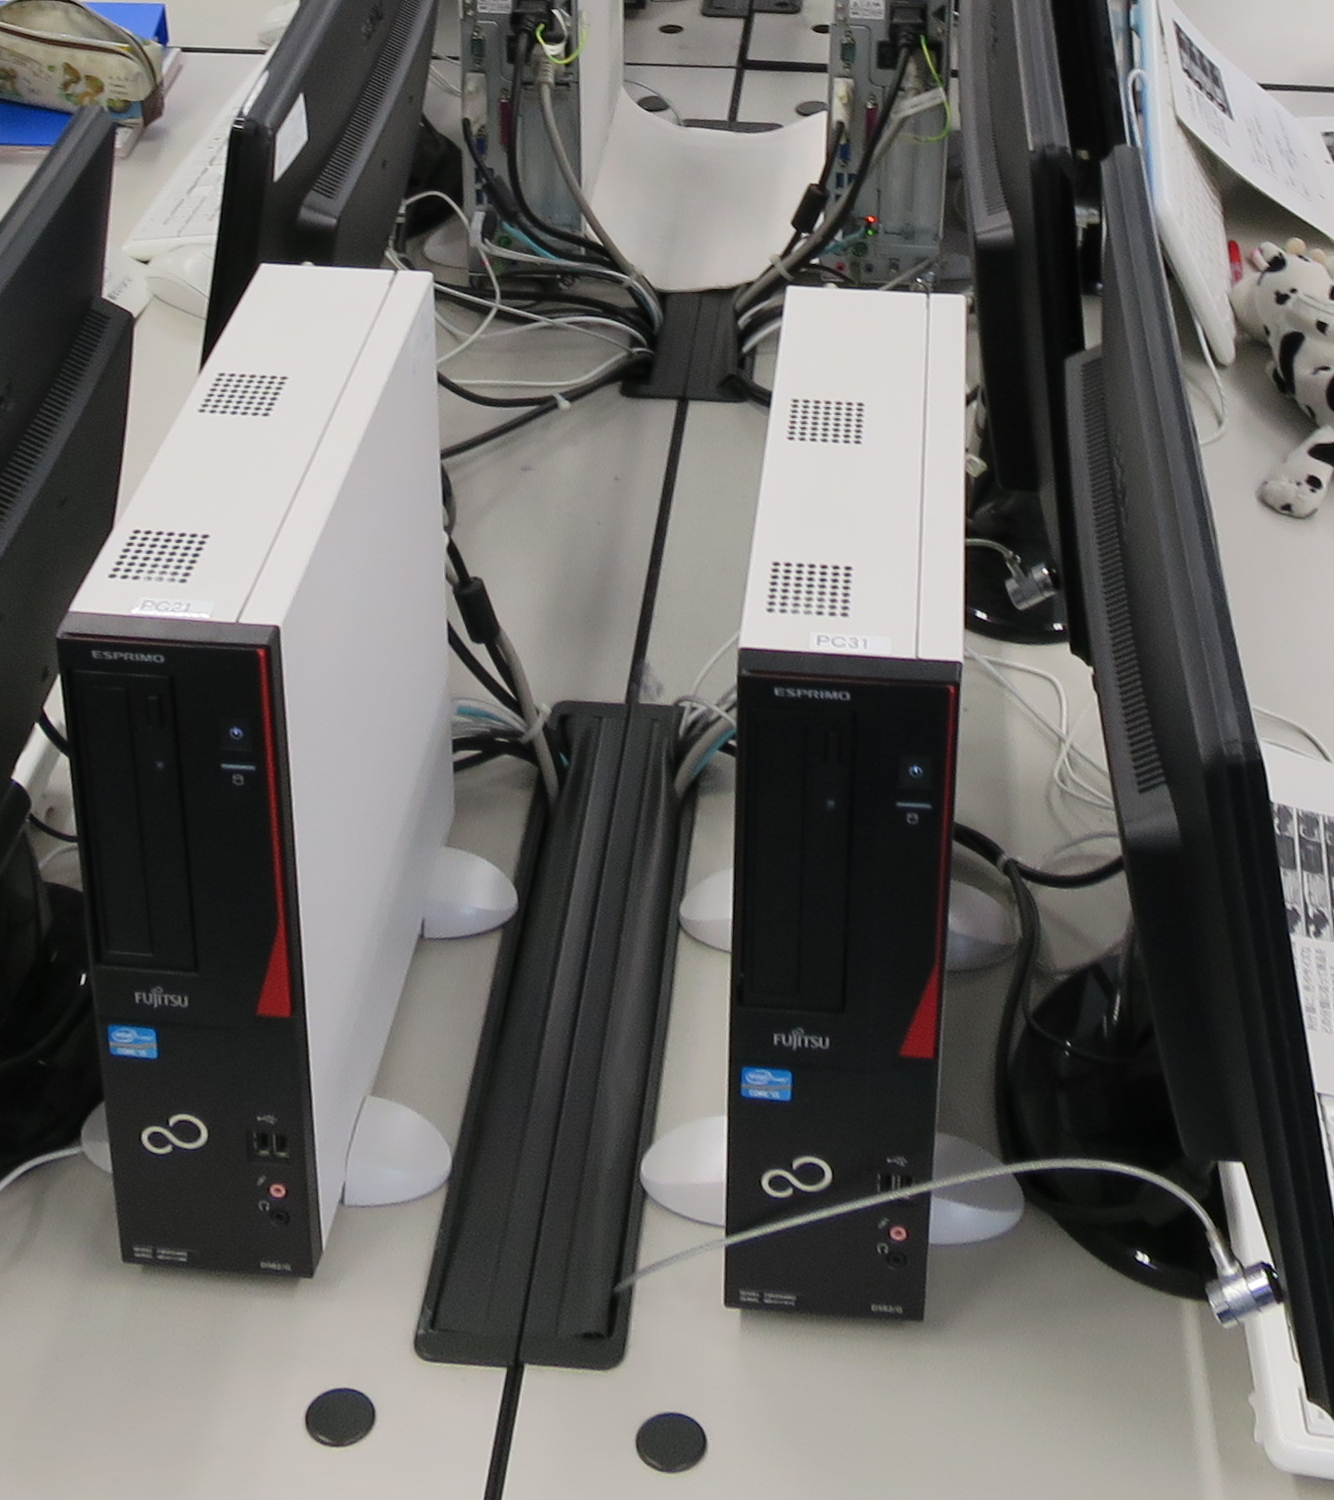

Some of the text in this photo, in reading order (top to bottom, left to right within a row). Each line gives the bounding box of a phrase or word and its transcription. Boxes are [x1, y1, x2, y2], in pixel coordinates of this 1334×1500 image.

[139, 598, 193, 614] PC21
[815, 633, 870, 651] PC31
[90, 649, 166, 665] ESPRIMO
[773, 686, 852, 702] ESPRIMO
[134, 985, 190, 1010] FUJITSU
[772, 1027, 831, 1051] FUJITSU
